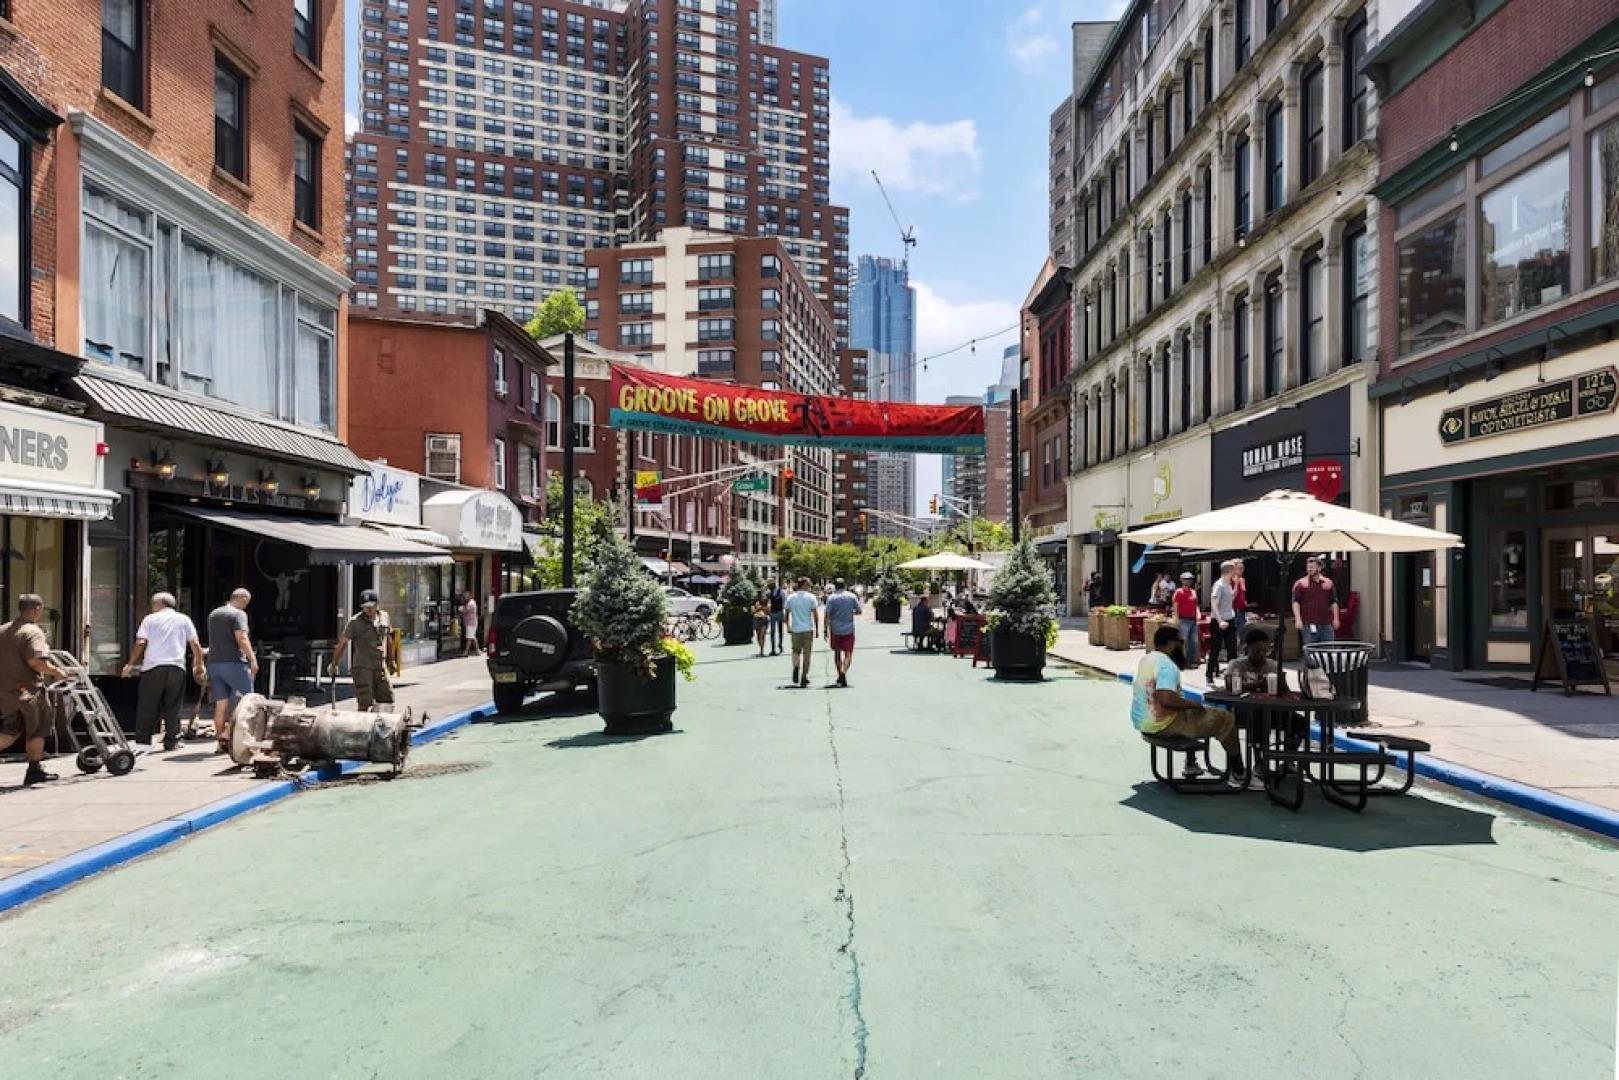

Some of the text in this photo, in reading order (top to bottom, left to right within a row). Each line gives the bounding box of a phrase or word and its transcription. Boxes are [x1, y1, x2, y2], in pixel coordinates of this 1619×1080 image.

[1585, 372, 1607, 389] 127
[619, 385, 699, 414] GROOVE
[703, 394, 729, 422] ON
[734, 396, 791, 423] GROVE
[1480, 407, 1557, 434] OPTOMETRISTS
